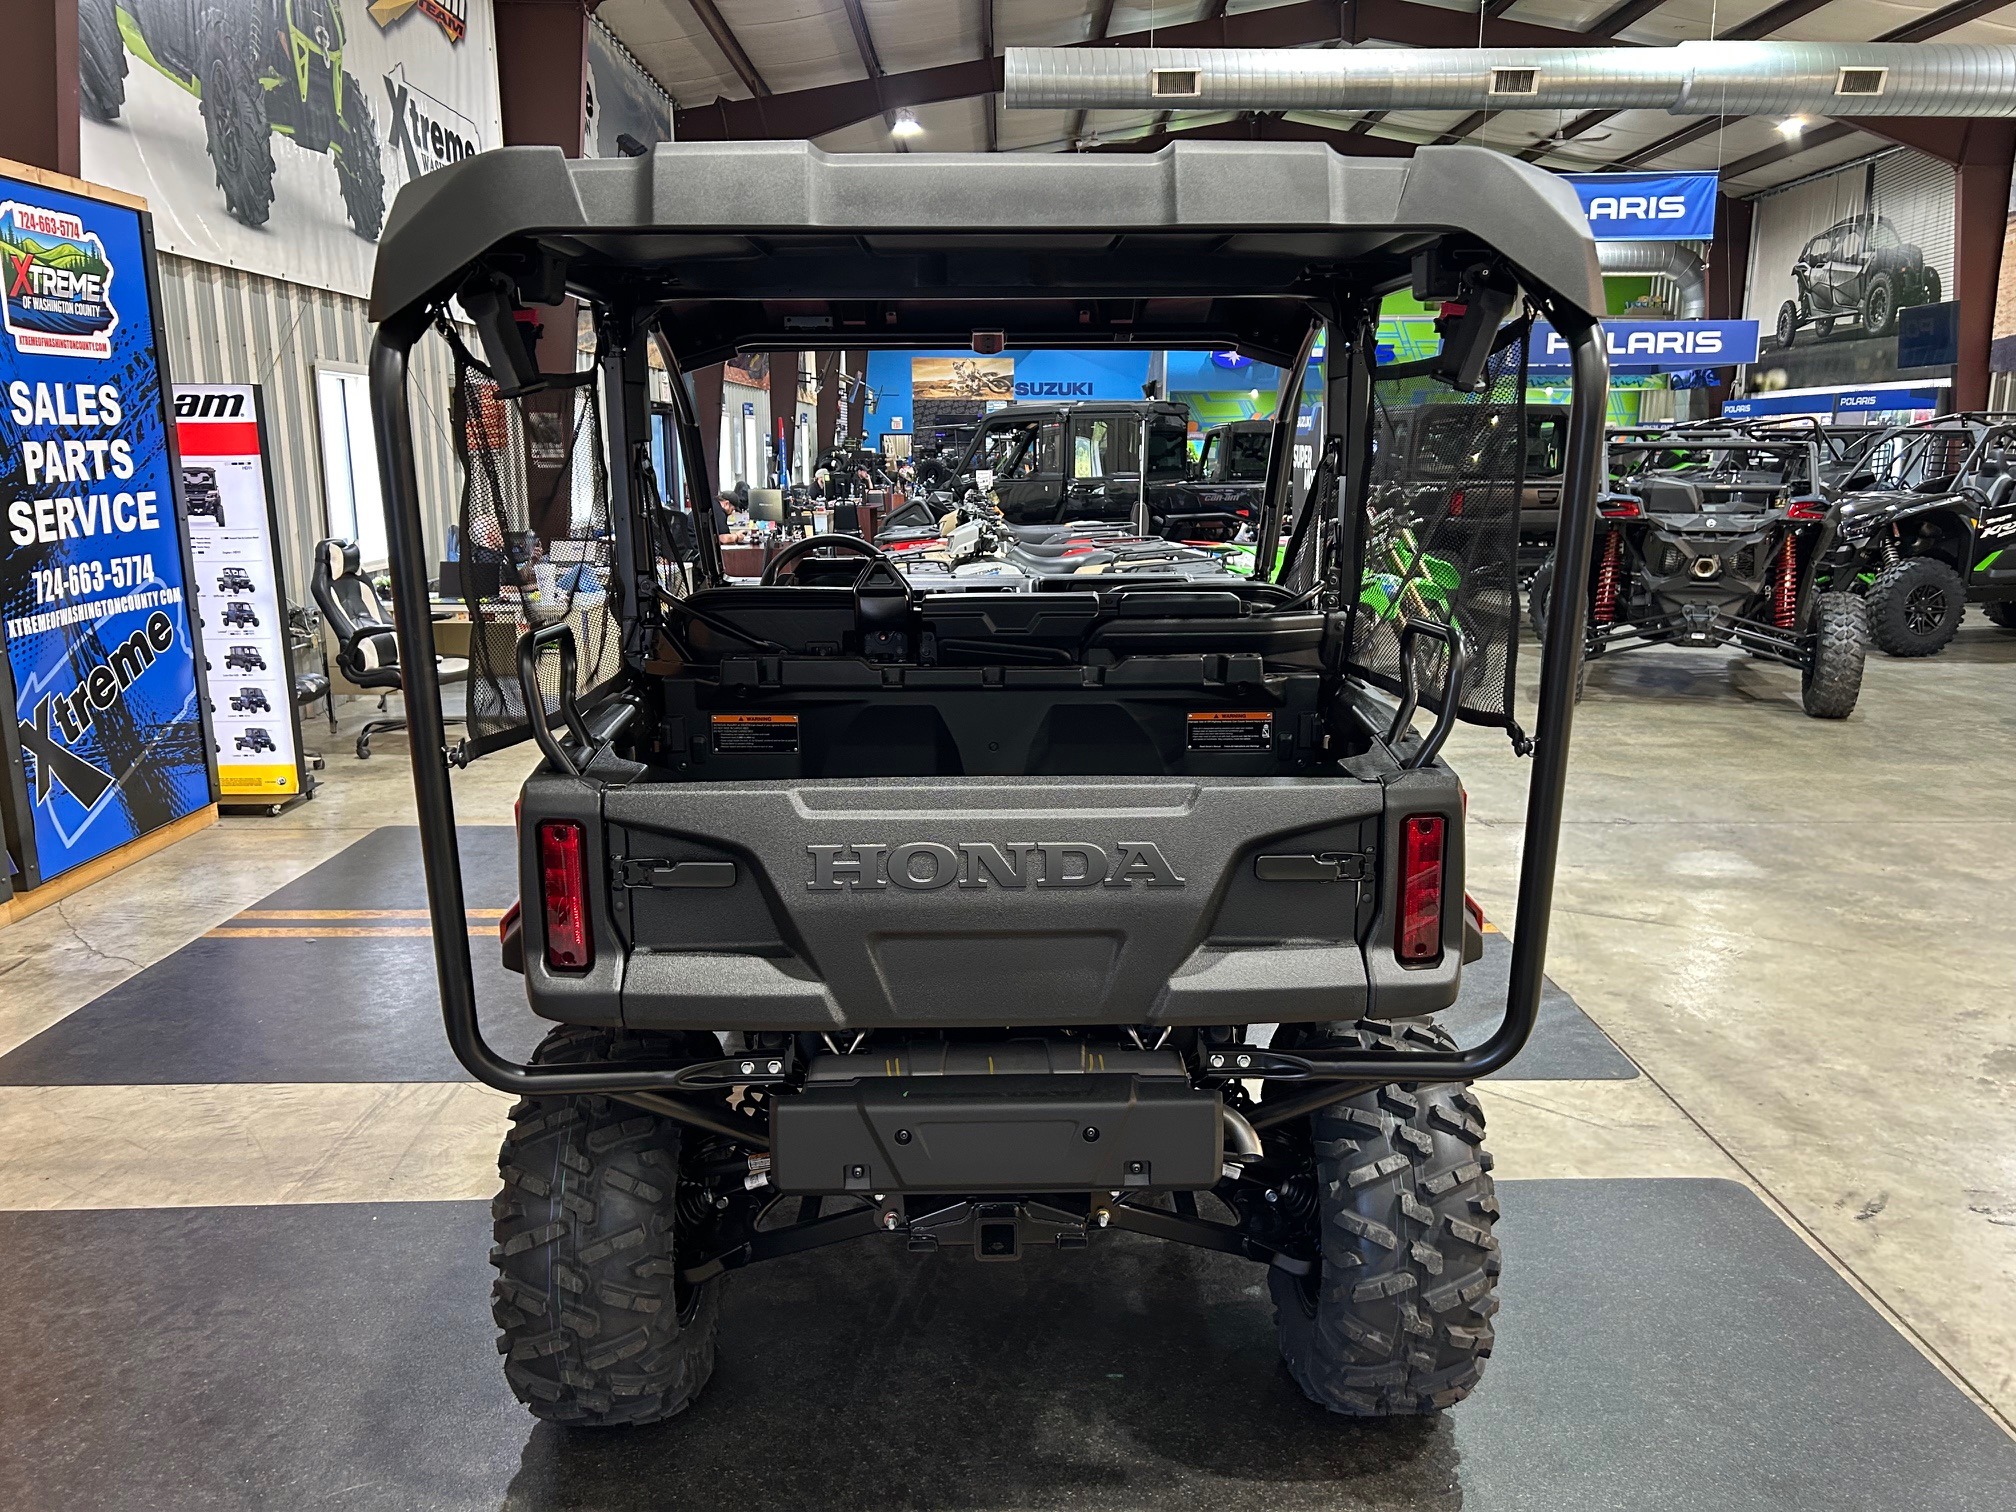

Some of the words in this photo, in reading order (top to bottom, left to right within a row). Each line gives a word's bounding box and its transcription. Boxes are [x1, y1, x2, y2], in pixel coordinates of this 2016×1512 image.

[418, 0, 465, 37] TEAM
[18, 210, 80, 239] 724-663-5774
[1584, 196, 1686, 220] ARIS
[9, 253, 101, 302] XTREME
[22, 295, 31, 310] OF
[33, 296, 74, 315] WASHINGTON
[74, 302, 100, 318] COUNTY
[1546, 331, 1723, 355] PLARIS
[9, 380, 121, 426] SALES
[1014, 382, 1094, 396] SUZUKI
[1840, 396, 1877, 406] POLARIS
[1724, 404, 1751, 414] POLARIS
[22, 439, 134, 485] PARTS
[8, 491, 160, 546] SERVICE
[31, 553, 155, 604] 724-663-5774
[19, 610, 174, 811] Xtreme
[805, 842, 1186, 890] HONDA
